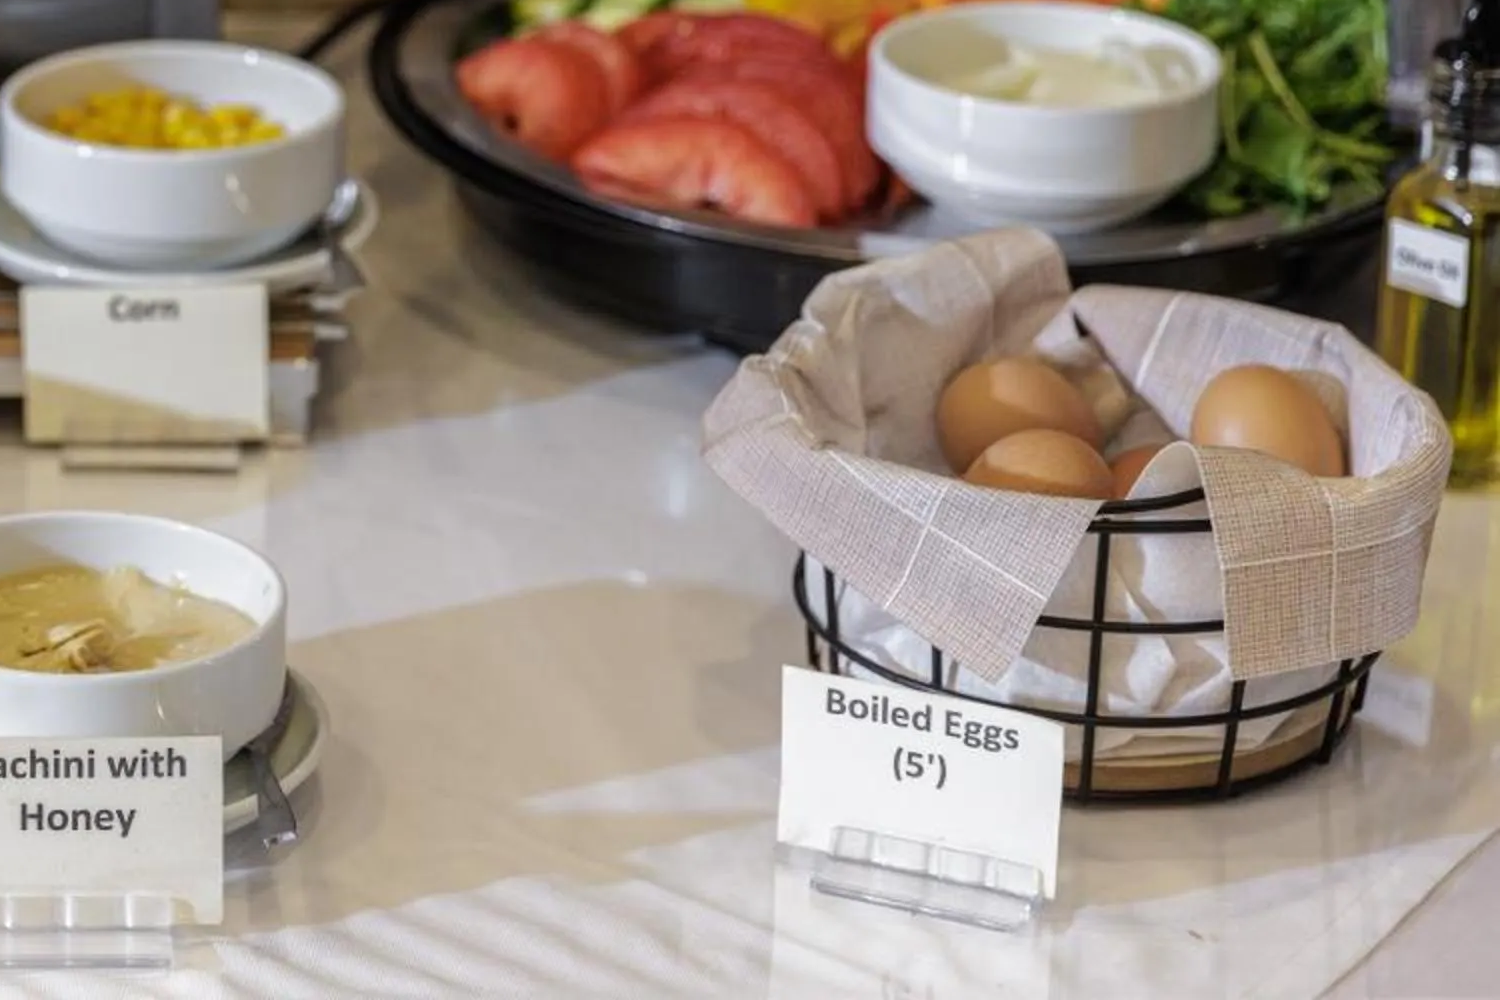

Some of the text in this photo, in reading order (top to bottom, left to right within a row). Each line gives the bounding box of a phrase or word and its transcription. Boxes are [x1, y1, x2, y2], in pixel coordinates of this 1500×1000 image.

[108, 296, 180, 321] Corn
[825, 687, 1020, 752] Boiled Eggs
[107, 748, 188, 778] with
[892, 747, 948, 790] (5')
[19, 803, 137, 838] Honey
